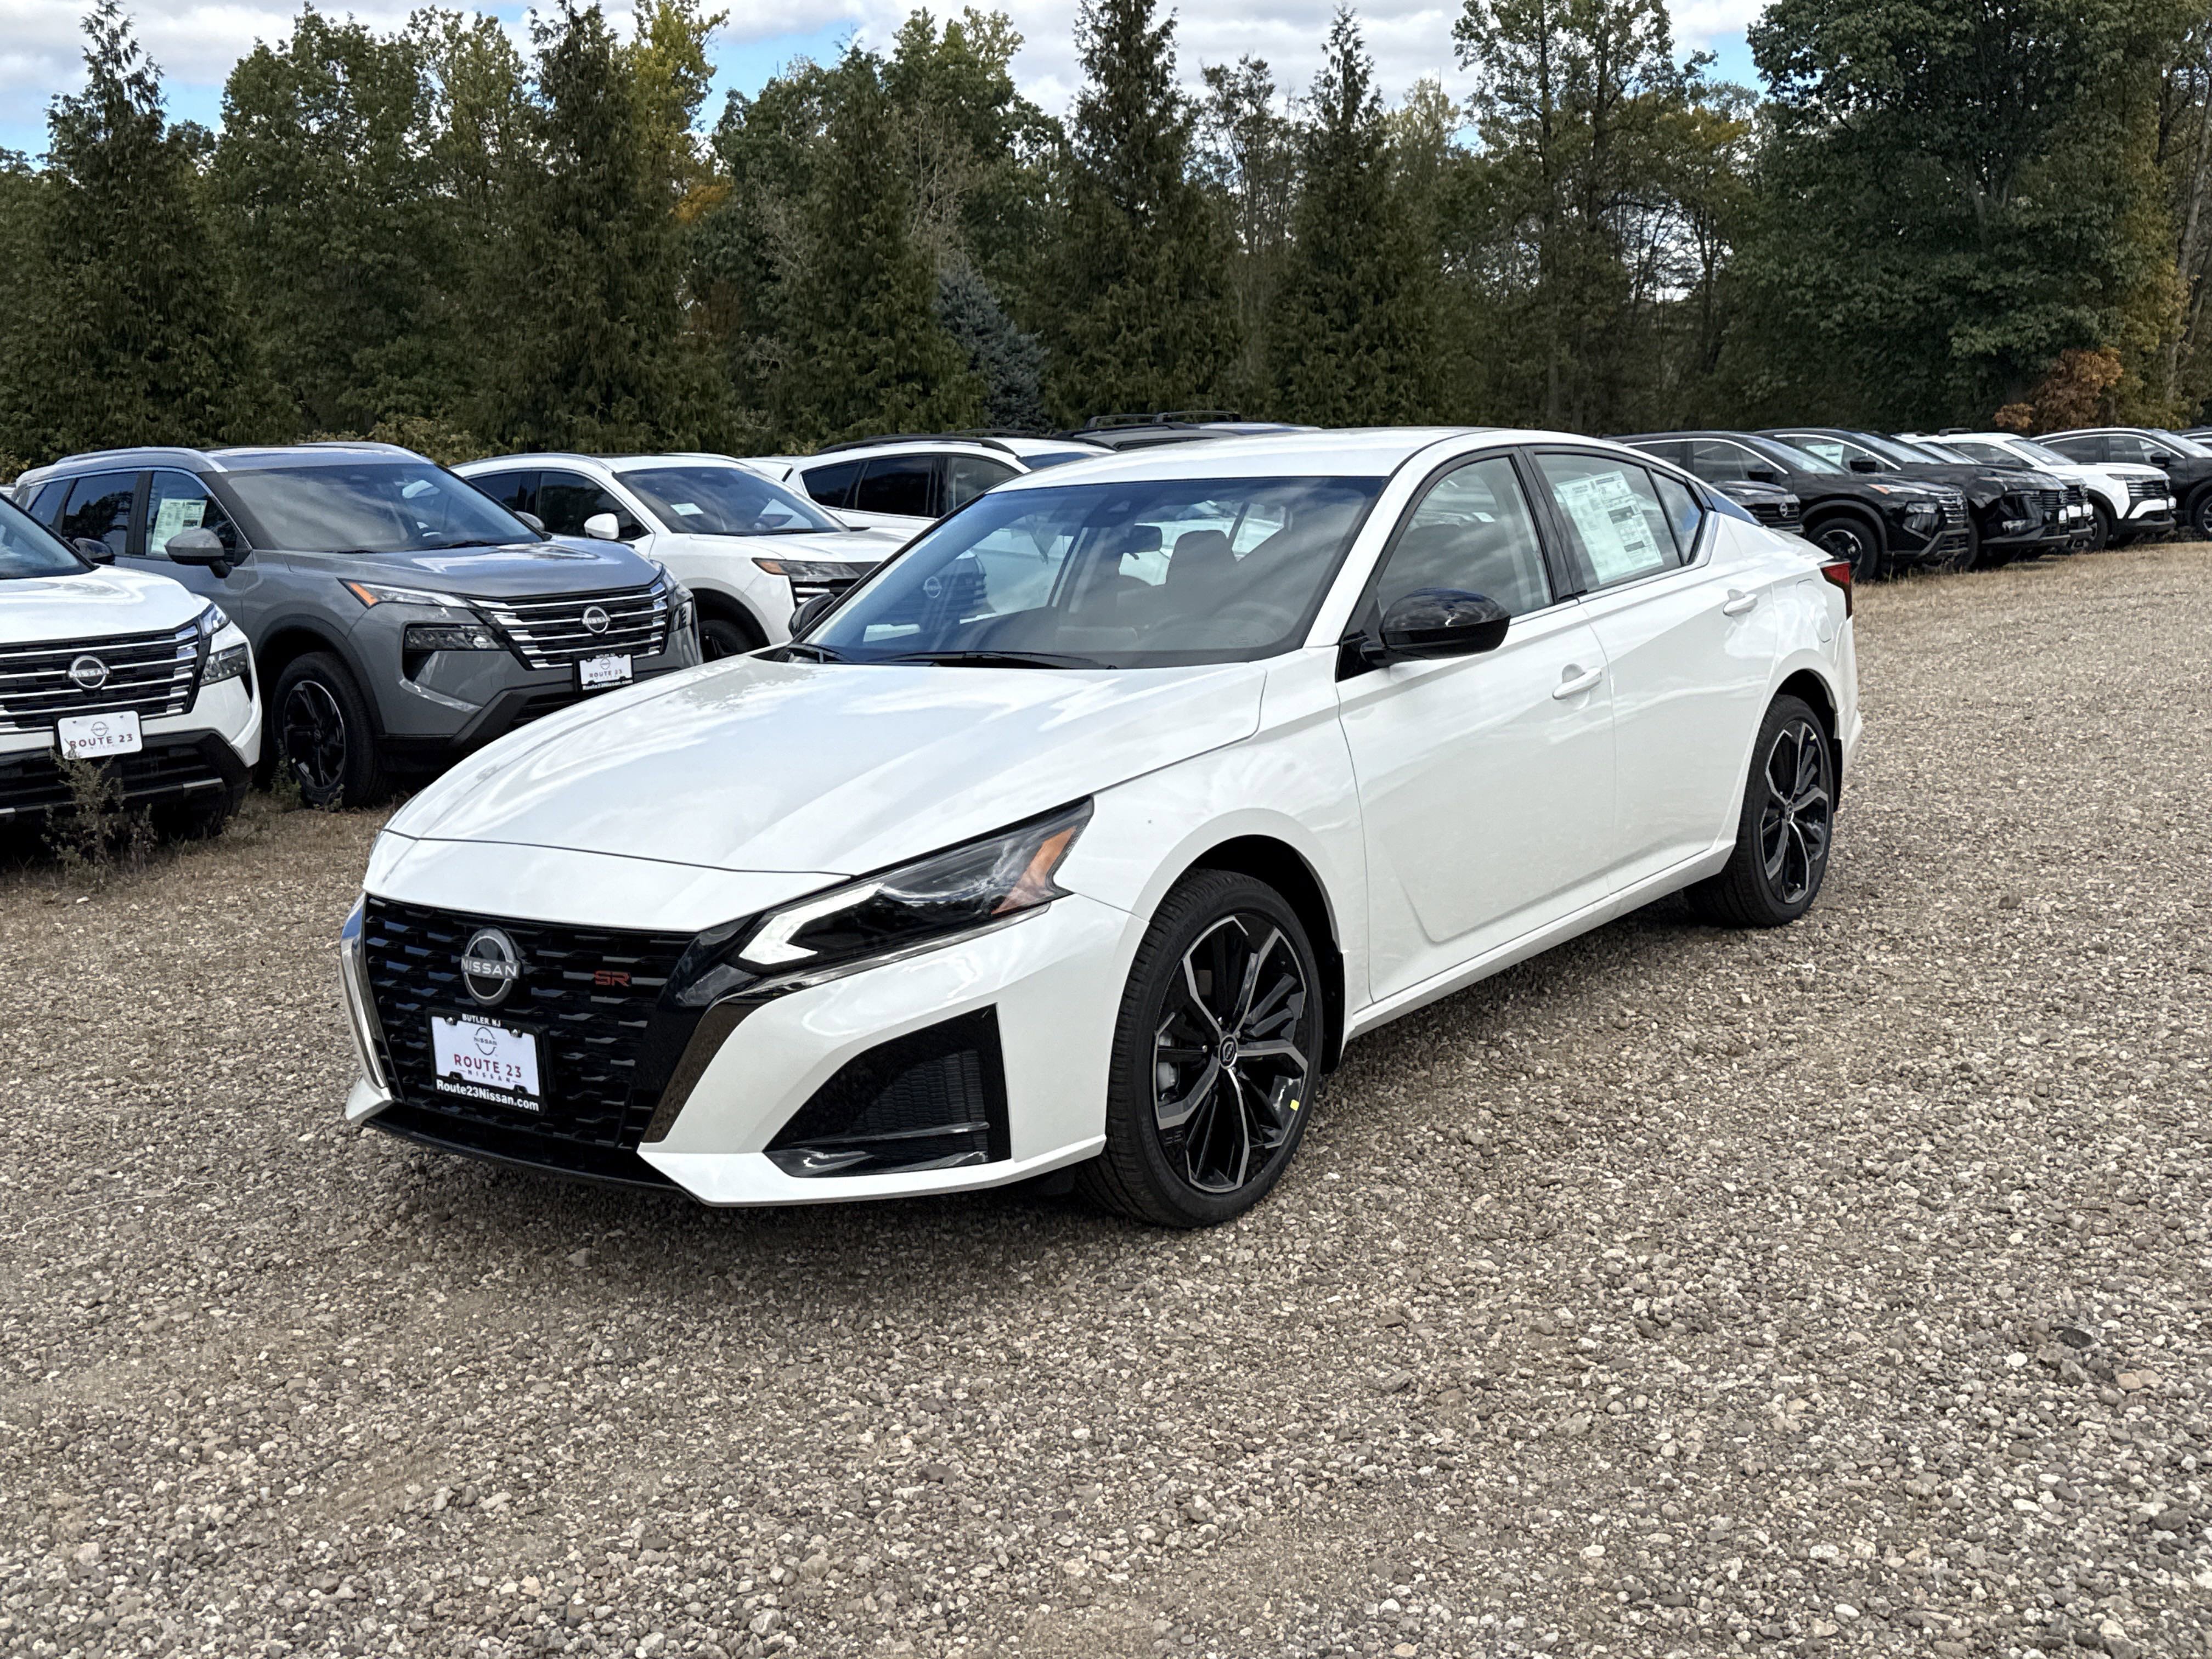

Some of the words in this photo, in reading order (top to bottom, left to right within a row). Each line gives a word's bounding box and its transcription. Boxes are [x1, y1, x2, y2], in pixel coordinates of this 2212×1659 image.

[70, 736, 112, 747] ROUTE
[119, 733, 133, 742] 23
[461, 957, 517, 977] NISSAN
[594, 970, 631, 987] SR
[473, 1036, 498, 1045] NISSAN
[454, 1054, 500, 1073] ROUTE
[506, 1064, 522, 1078] 23
[468, 1069, 511, 1082] NISSAN
[436, 1079, 539, 1111] Route23Nissan.com
